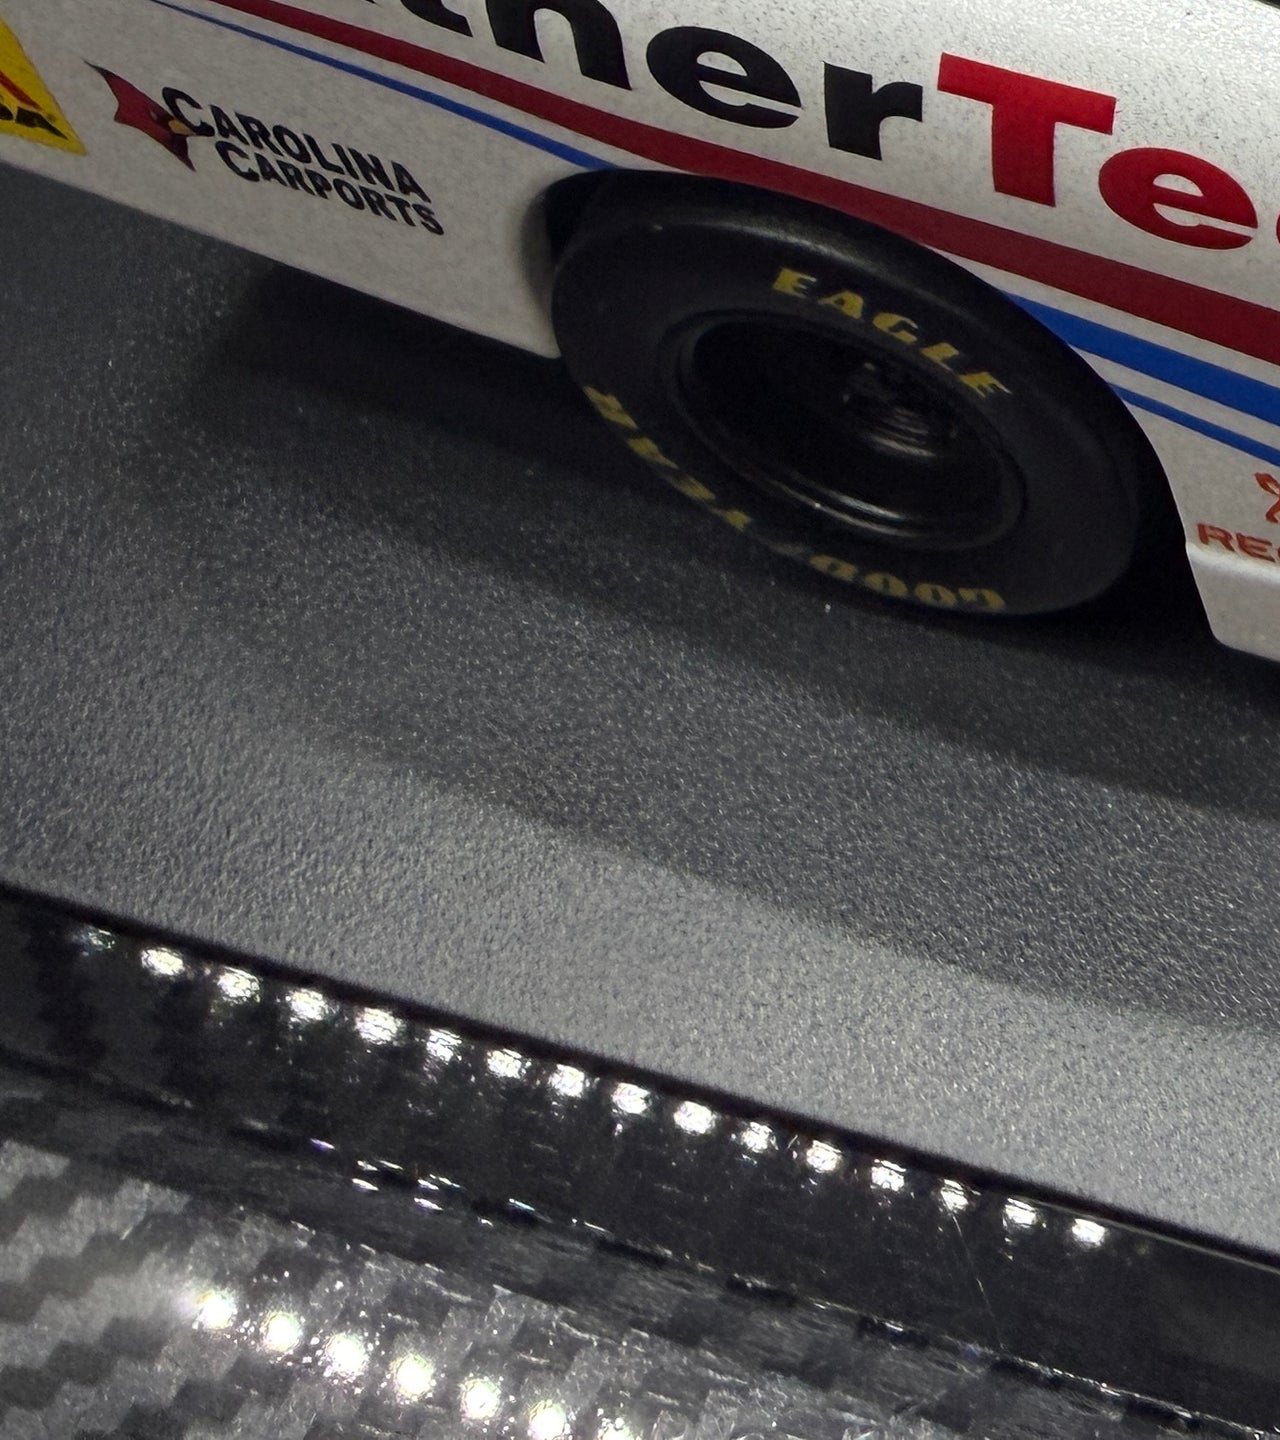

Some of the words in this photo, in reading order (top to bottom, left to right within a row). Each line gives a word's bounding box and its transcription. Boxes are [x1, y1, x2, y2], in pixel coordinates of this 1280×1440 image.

[162, 86, 432, 204] CAROLINA
[215, 140, 445, 237] CARPORTS
[771, 266, 1013, 399] EAGLE
